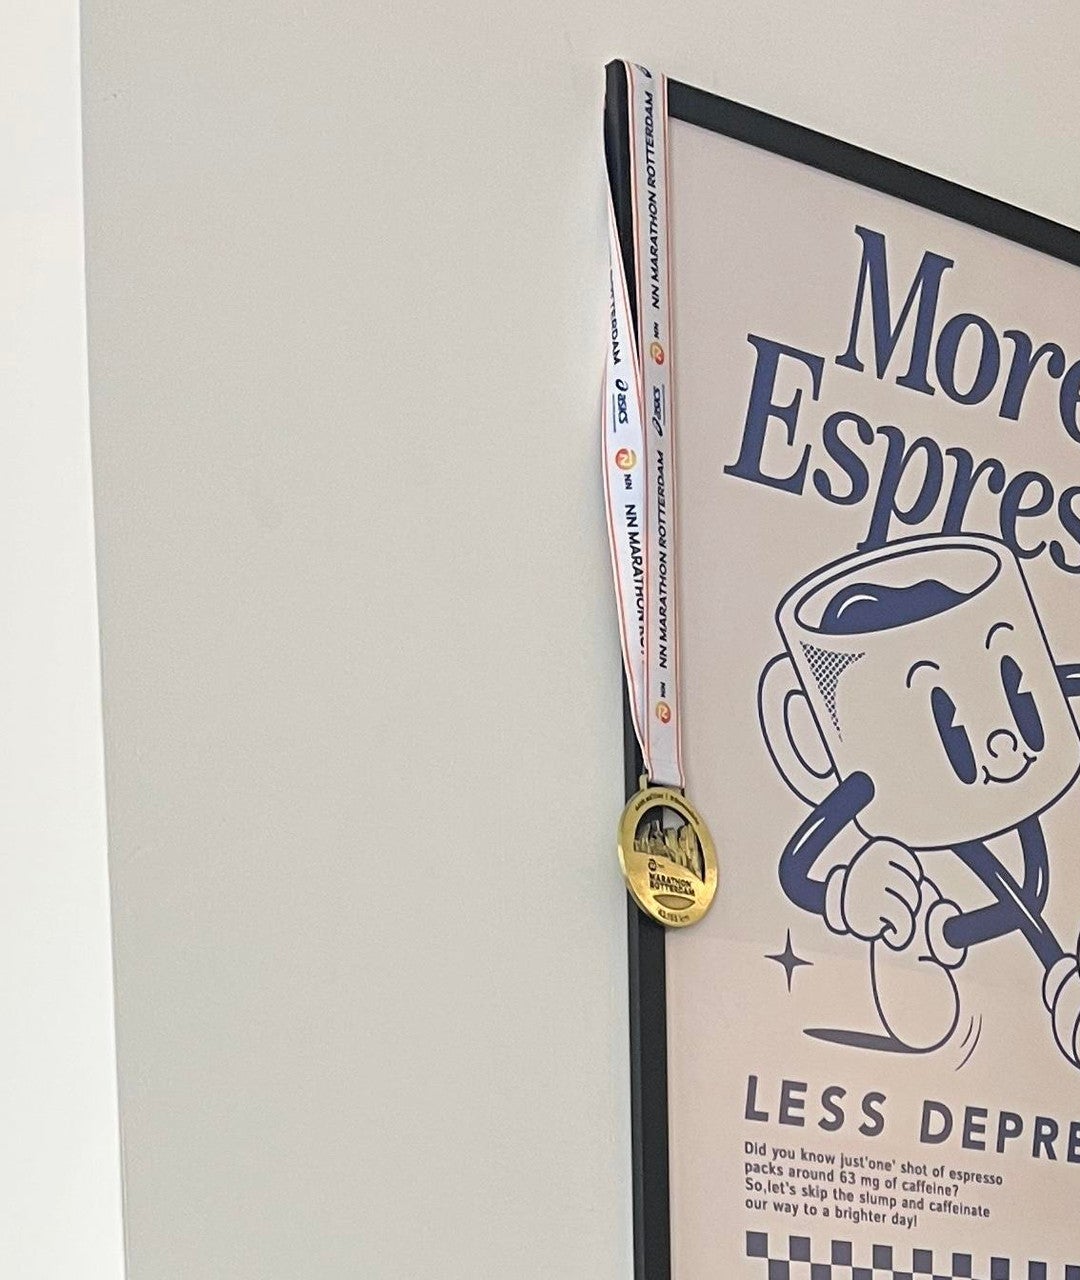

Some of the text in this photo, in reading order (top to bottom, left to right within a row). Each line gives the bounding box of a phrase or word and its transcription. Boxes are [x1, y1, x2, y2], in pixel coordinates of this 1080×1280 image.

[644, 90, 660, 309] NN MARATHON ROTTERDAM
[624, 504, 639, 530] NN
[656, 450, 668, 669] NN MARATHON ROTTERDAM
[744, 1075, 887, 1138] LESS
[744, 1141, 767, 1157] Did
[772, 1146, 796, 1162] you
[801, 1148, 835, 1165] know
[901, 1161, 927, 1177] shot
[932, 1166, 945, 1179] of
[949, 1169, 1003, 1186] espresso
[744, 1161, 959, 1197] packs around 63 mg of caffeine?
[745, 1198, 918, 1229] our way to a brighter day!
[801, 1184, 828, 1202] skip
[833, 1187, 855, 1203] the
[859, 1191, 897, 1210] slump
[901, 1197, 925, 1211] and
[929, 1199, 991, 1218] caffeinate
